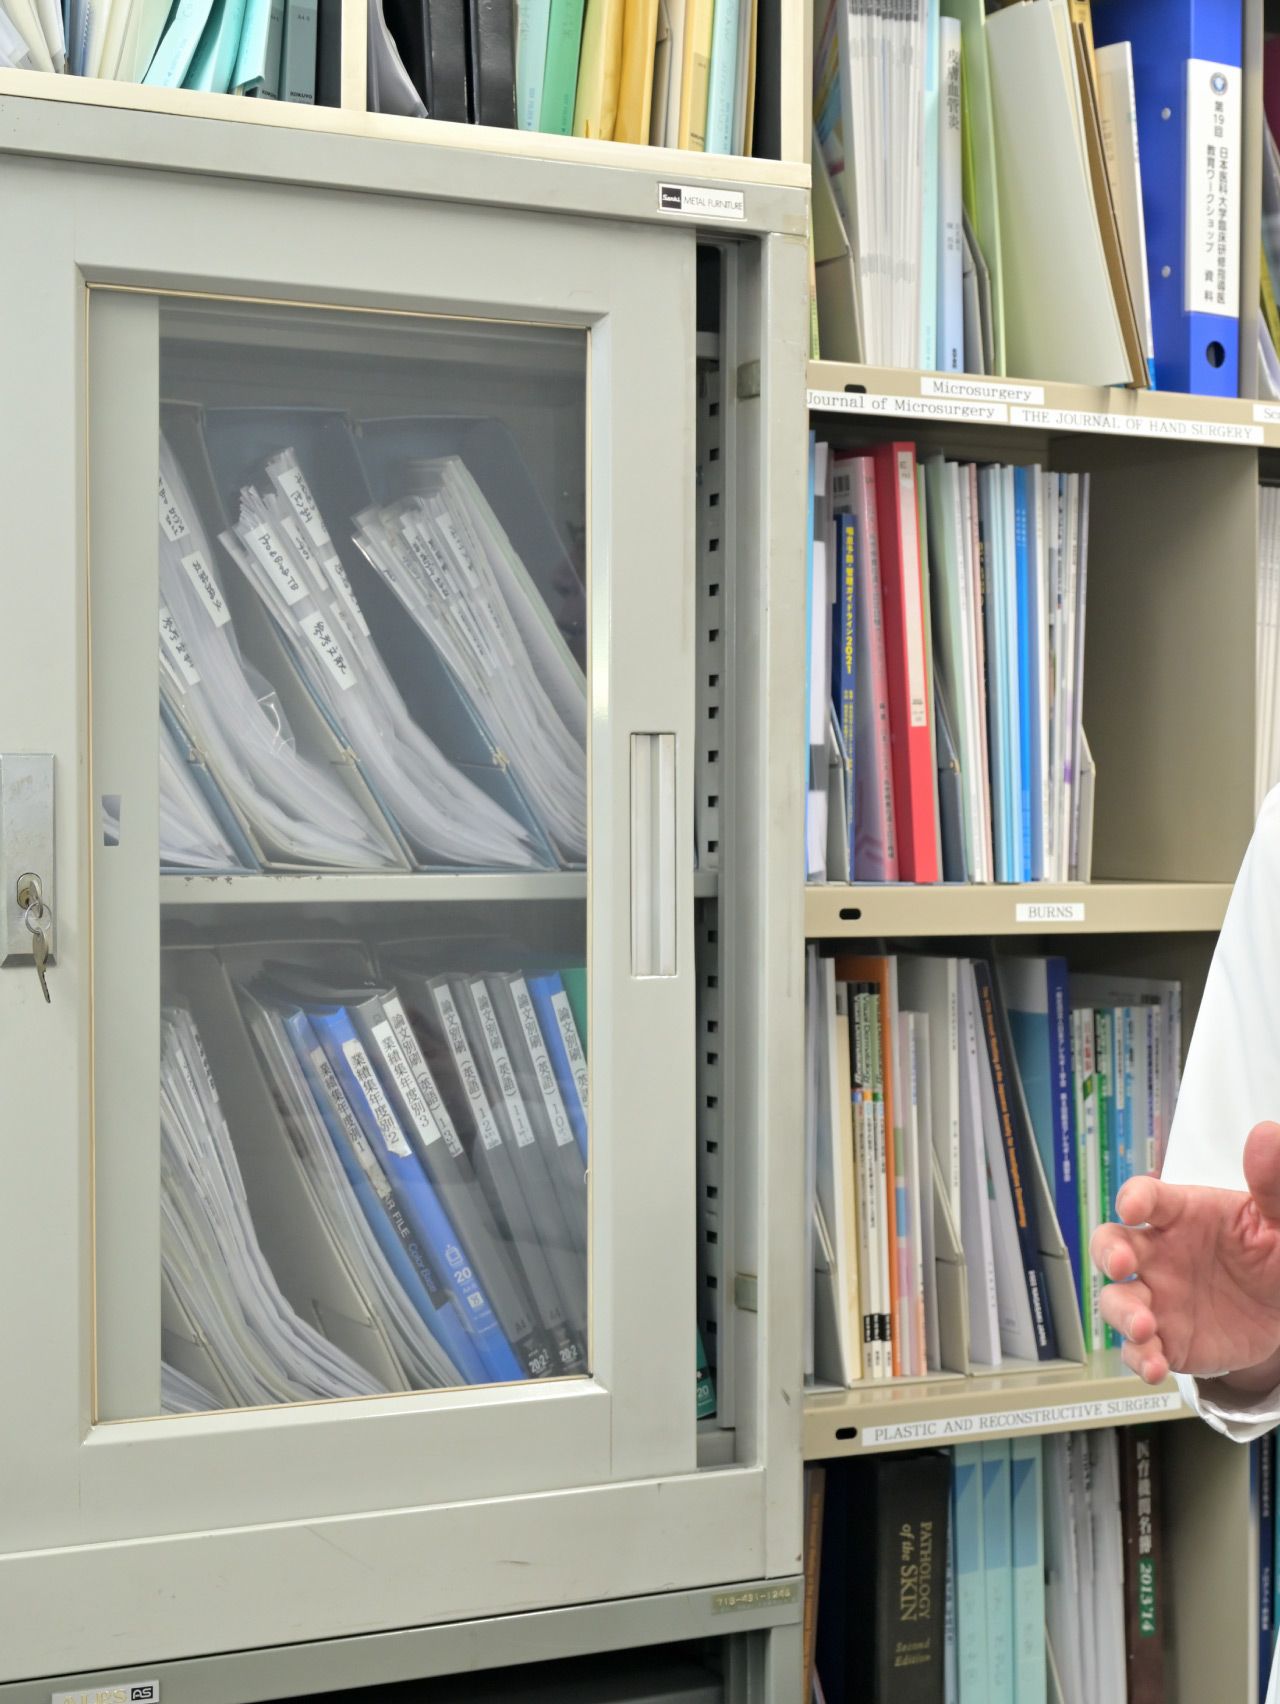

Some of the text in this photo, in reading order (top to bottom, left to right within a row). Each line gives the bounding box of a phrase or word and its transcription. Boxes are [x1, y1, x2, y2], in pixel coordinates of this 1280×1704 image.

[289, 91, 313, 100] KOKUYO
[946, 49, 960, 131] 皮膚血管炎
[1214, 100, 1224, 138] 第19回
[683, 195, 706, 208] METAL
[707, 198, 743, 211] FURNITURE
[1205, 144, 1216, 254] 教育ワークショップ
[1217, 146, 1229, 305] 日本医科大学臨床研修指導医
[807, 390, 996, 419] Journal of Microsurgery
[932, 380, 1032, 402] Microsurgery
[1021, 408, 1253, 440] THE JOURNAL OF HAND SURGERY
[1028, 905, 1074, 919] BURNS
[862, 993, 872, 1085] Visual Dermatology
[318, 1062, 366, 1153] 業績集年度別1
[351, 1052, 400, 1144] 業績集年度別2
[381, 1035, 430, 1128] 業績集年度別3
[392, 1210, 411, 1239] FILE
[407, 1242, 425, 1273] Color
[453, 1267, 473, 1284] 20
[873, 1395, 1171, 1442] PLASTIC AND RECONSTRUCTIVE SURGERY
[1135, 1439, 1154, 1555] 医育機関名簿
[899, 1523, 918, 1622] of the SKIN
[919, 1521, 933, 1619] PATHOLOGY
[894, 1653, 932, 1668] Edition
[895, 1637, 931, 1653] Second
